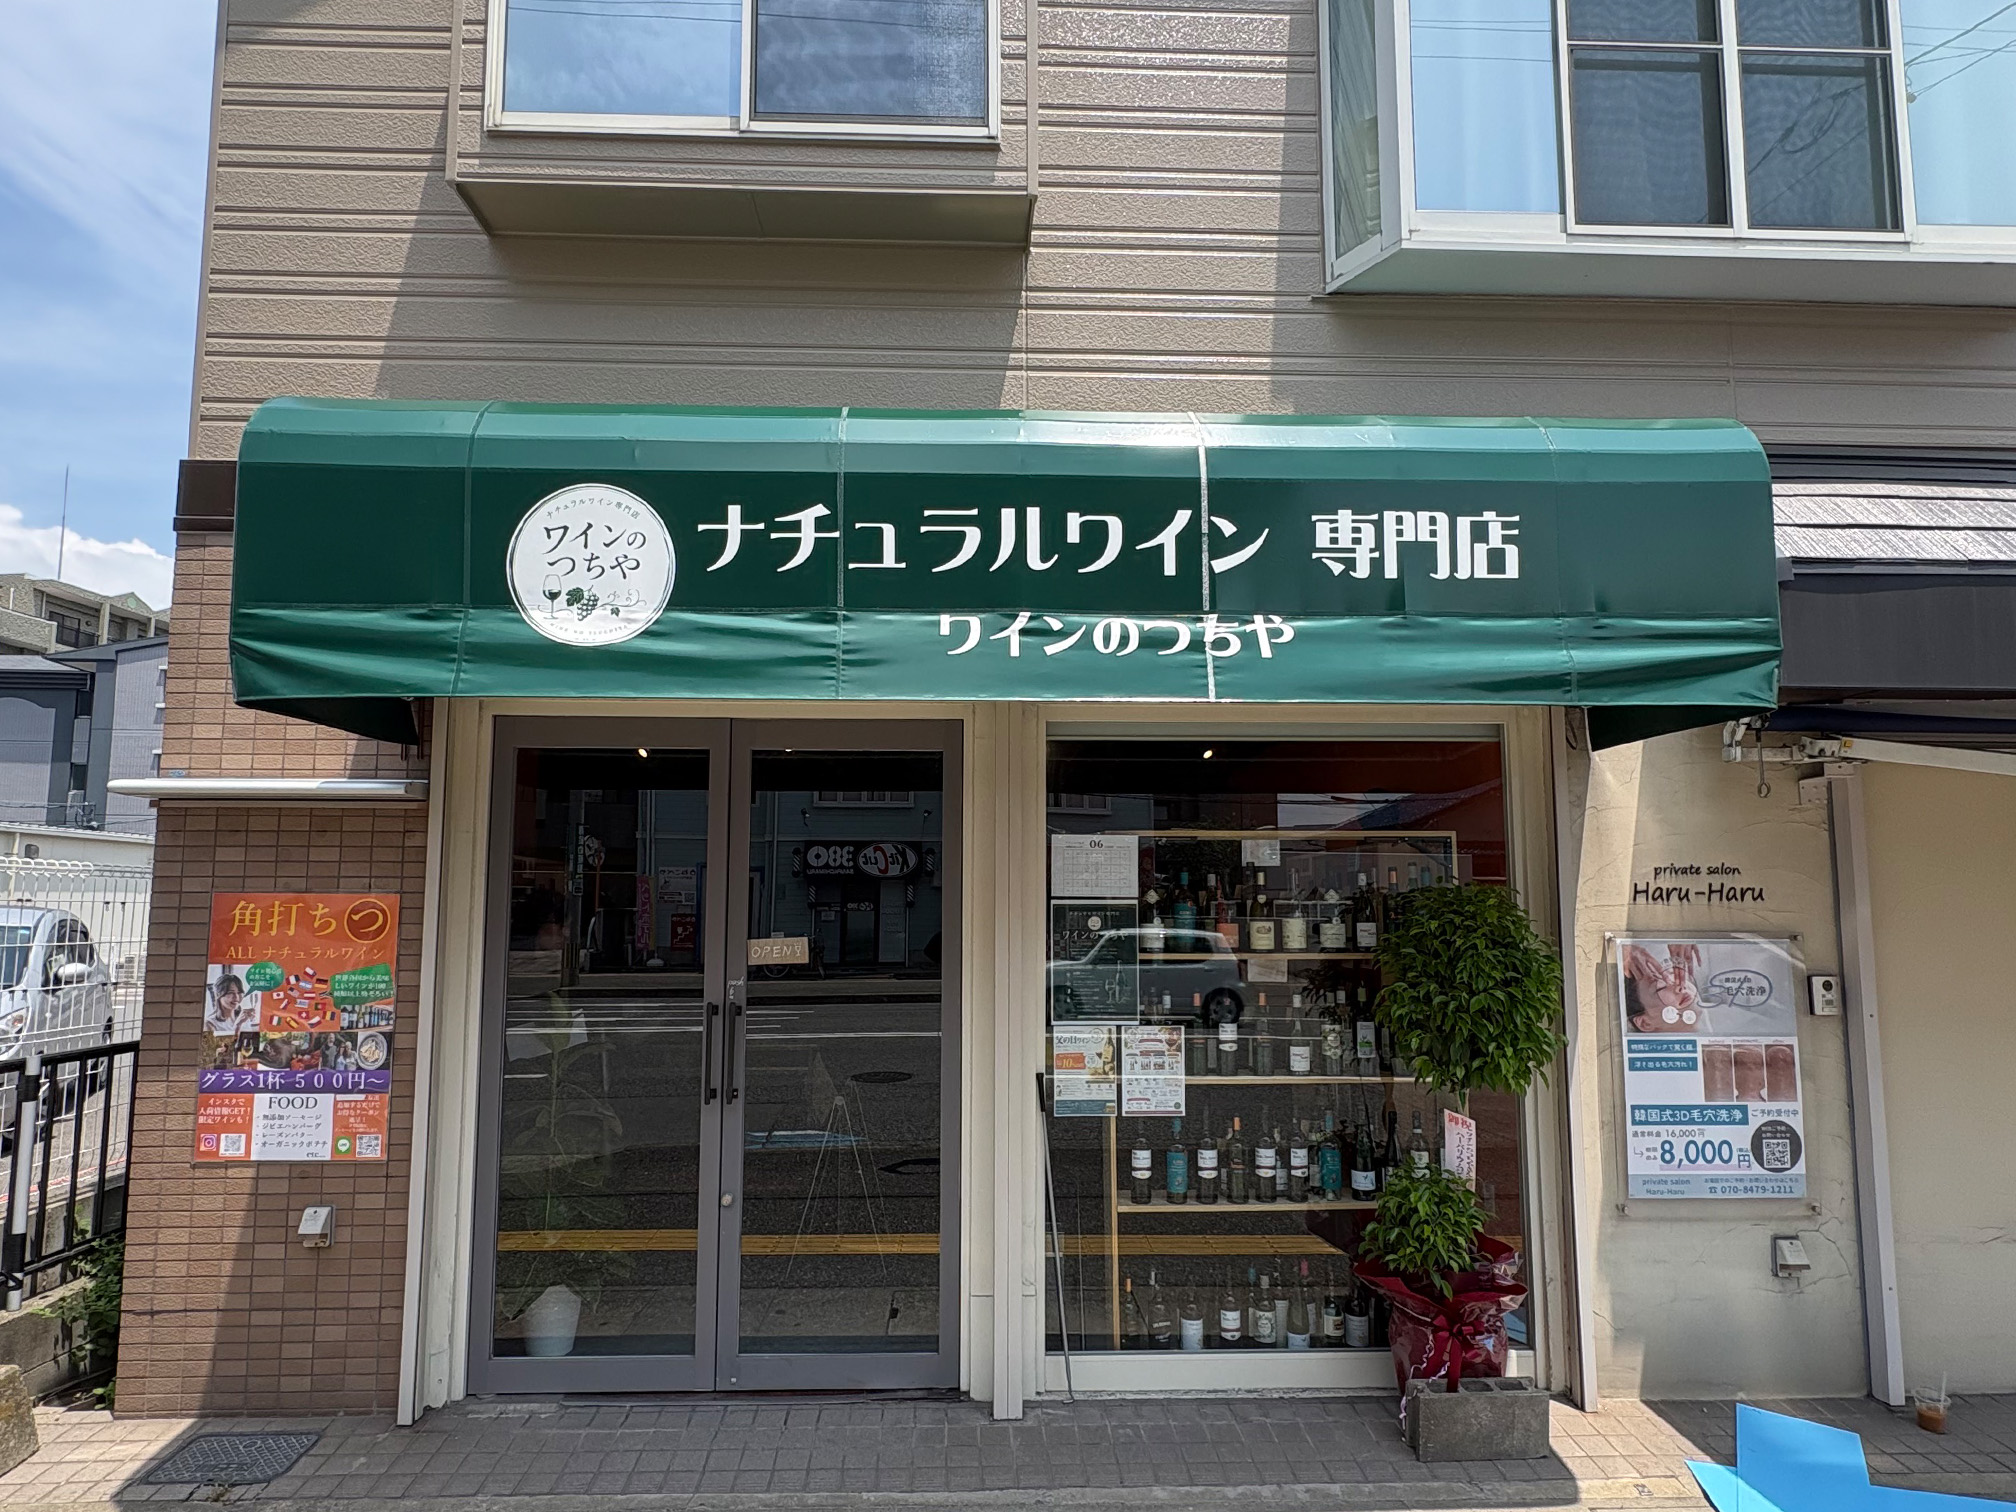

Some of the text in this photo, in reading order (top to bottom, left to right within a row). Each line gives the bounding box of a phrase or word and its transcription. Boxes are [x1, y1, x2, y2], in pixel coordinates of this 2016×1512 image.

[543, 522, 646, 554] ワインの
[697, 503, 1521, 580] ナチュラルワイン 専門店
[547, 552, 641, 580] つちや
[938, 611, 1295, 659] ワインのつちや
[1089, 839, 1104, 848] 06
[1654, 863, 1741, 881] private salon
[1633, 883, 1765, 905] Haru-Haru
[228, 899, 383, 937] 角打ち つ
[225, 946, 386, 960] ALL ナチュラルワイン
[751, 945, 792, 958] OPEN
[200, 1071, 285, 1090] グラス1杯
[208, 1097, 245, 1105] インスタで
[268, 1096, 318, 1109] FOOD
[1634, 1109, 1743, 1123] 韓国式3D毛穴洗浄
[1751, 1108, 1799, 1117] ご予約受付中
[1631, 1129, 1662, 1138] 通常料金
[1642, 1178, 1668, 1186] private
[1720, 1186, 1794, 1194] 070-8479-1211
